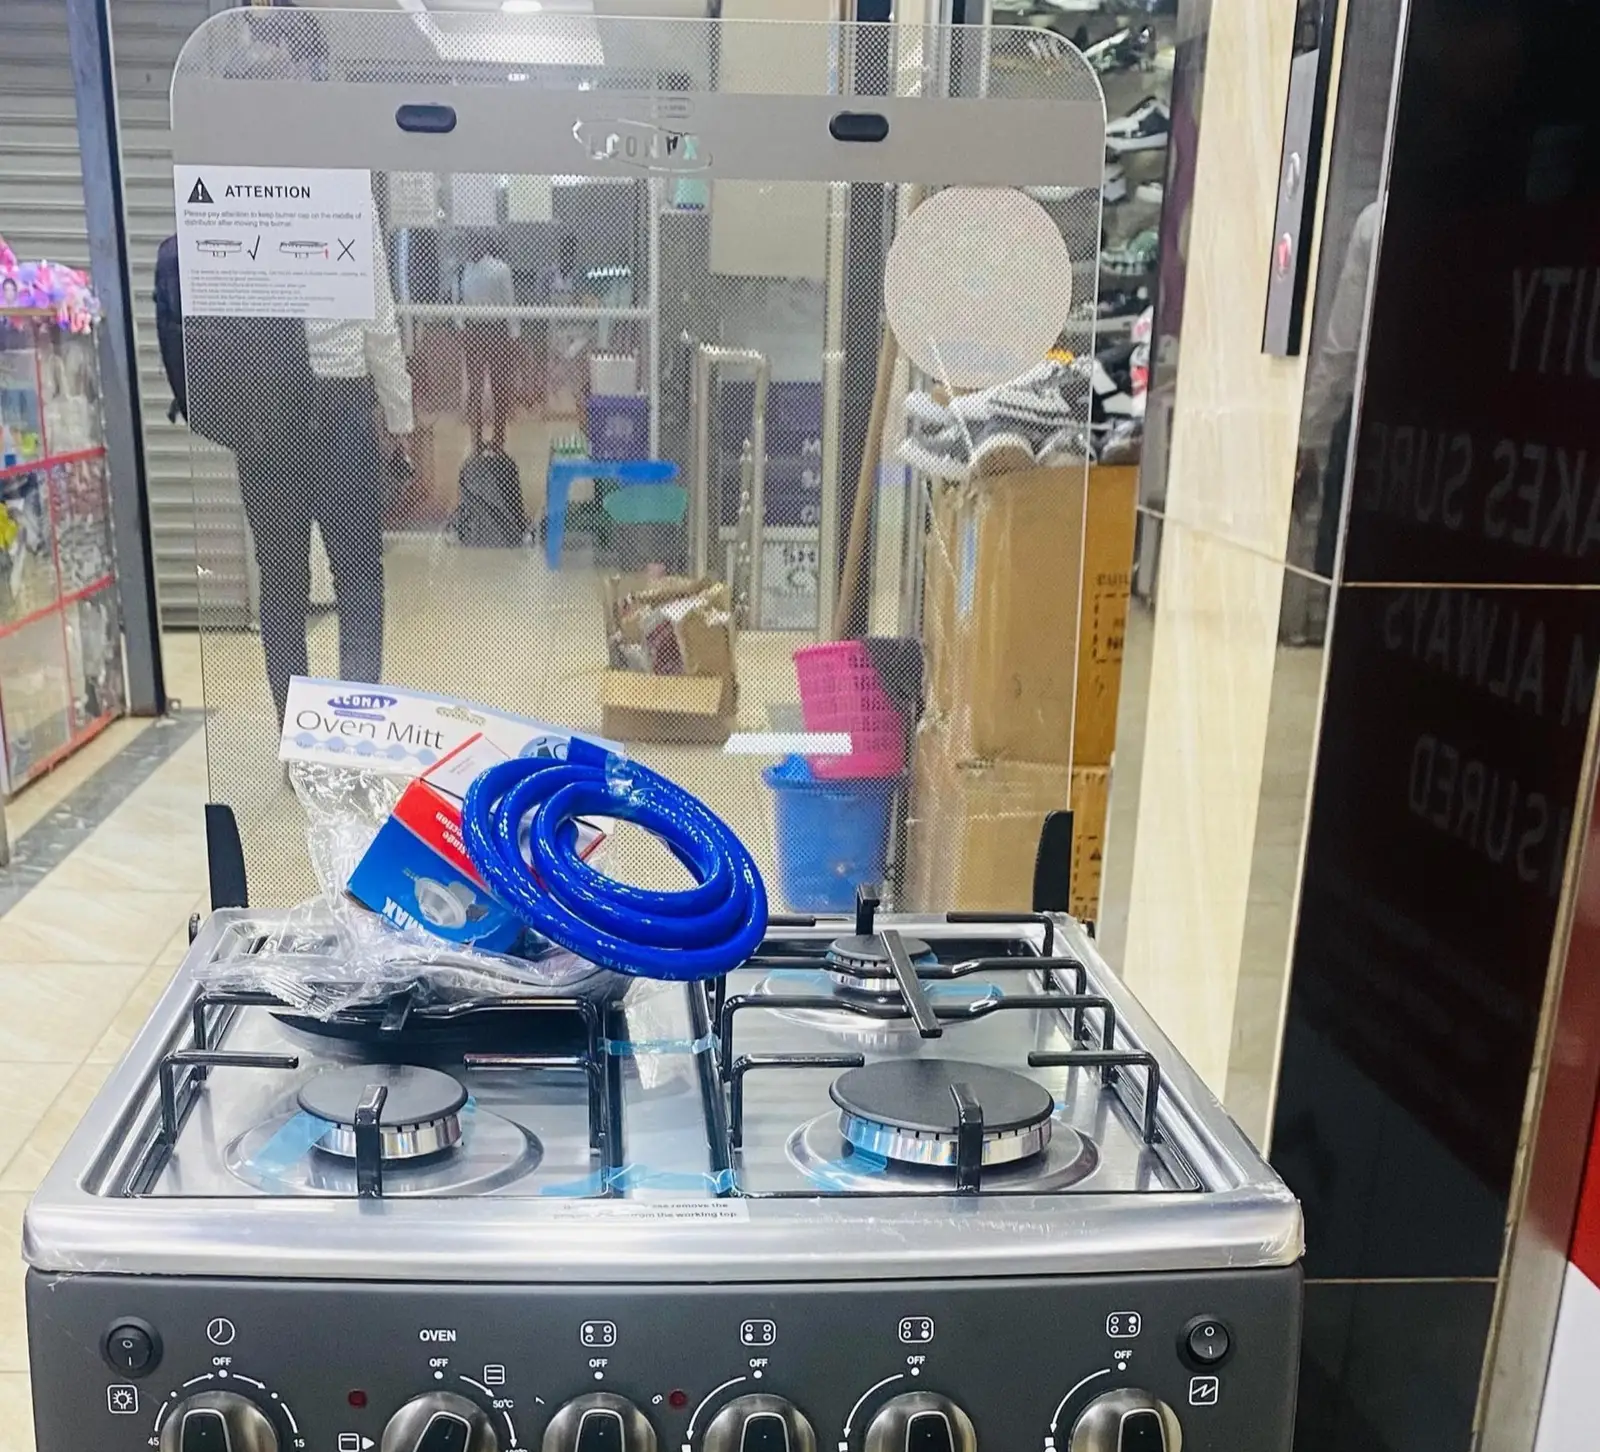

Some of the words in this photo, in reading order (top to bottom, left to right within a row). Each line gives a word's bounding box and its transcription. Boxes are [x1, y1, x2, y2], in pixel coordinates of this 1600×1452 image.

[225, 186, 311, 198] ATTENTION
[184, 209, 207, 217] Please
[296, 710, 377, 739] Oven
[386, 721, 444, 750] Mitt
[675, 1211, 718, 1219] working
[419, 1330, 457, 1342] OVEN
[1114, 1350, 1132, 1359] OFF
[212, 1357, 232, 1366] OFF
[429, 1358, 449, 1367] OFF
[588, 1359, 608, 1368] OFF
[749, 1358, 768, 1367] OFF
[907, 1356, 926, 1365] OFF
[147, 1437, 160, 1446] 45
[293, 1439, 305, 1448] 15
